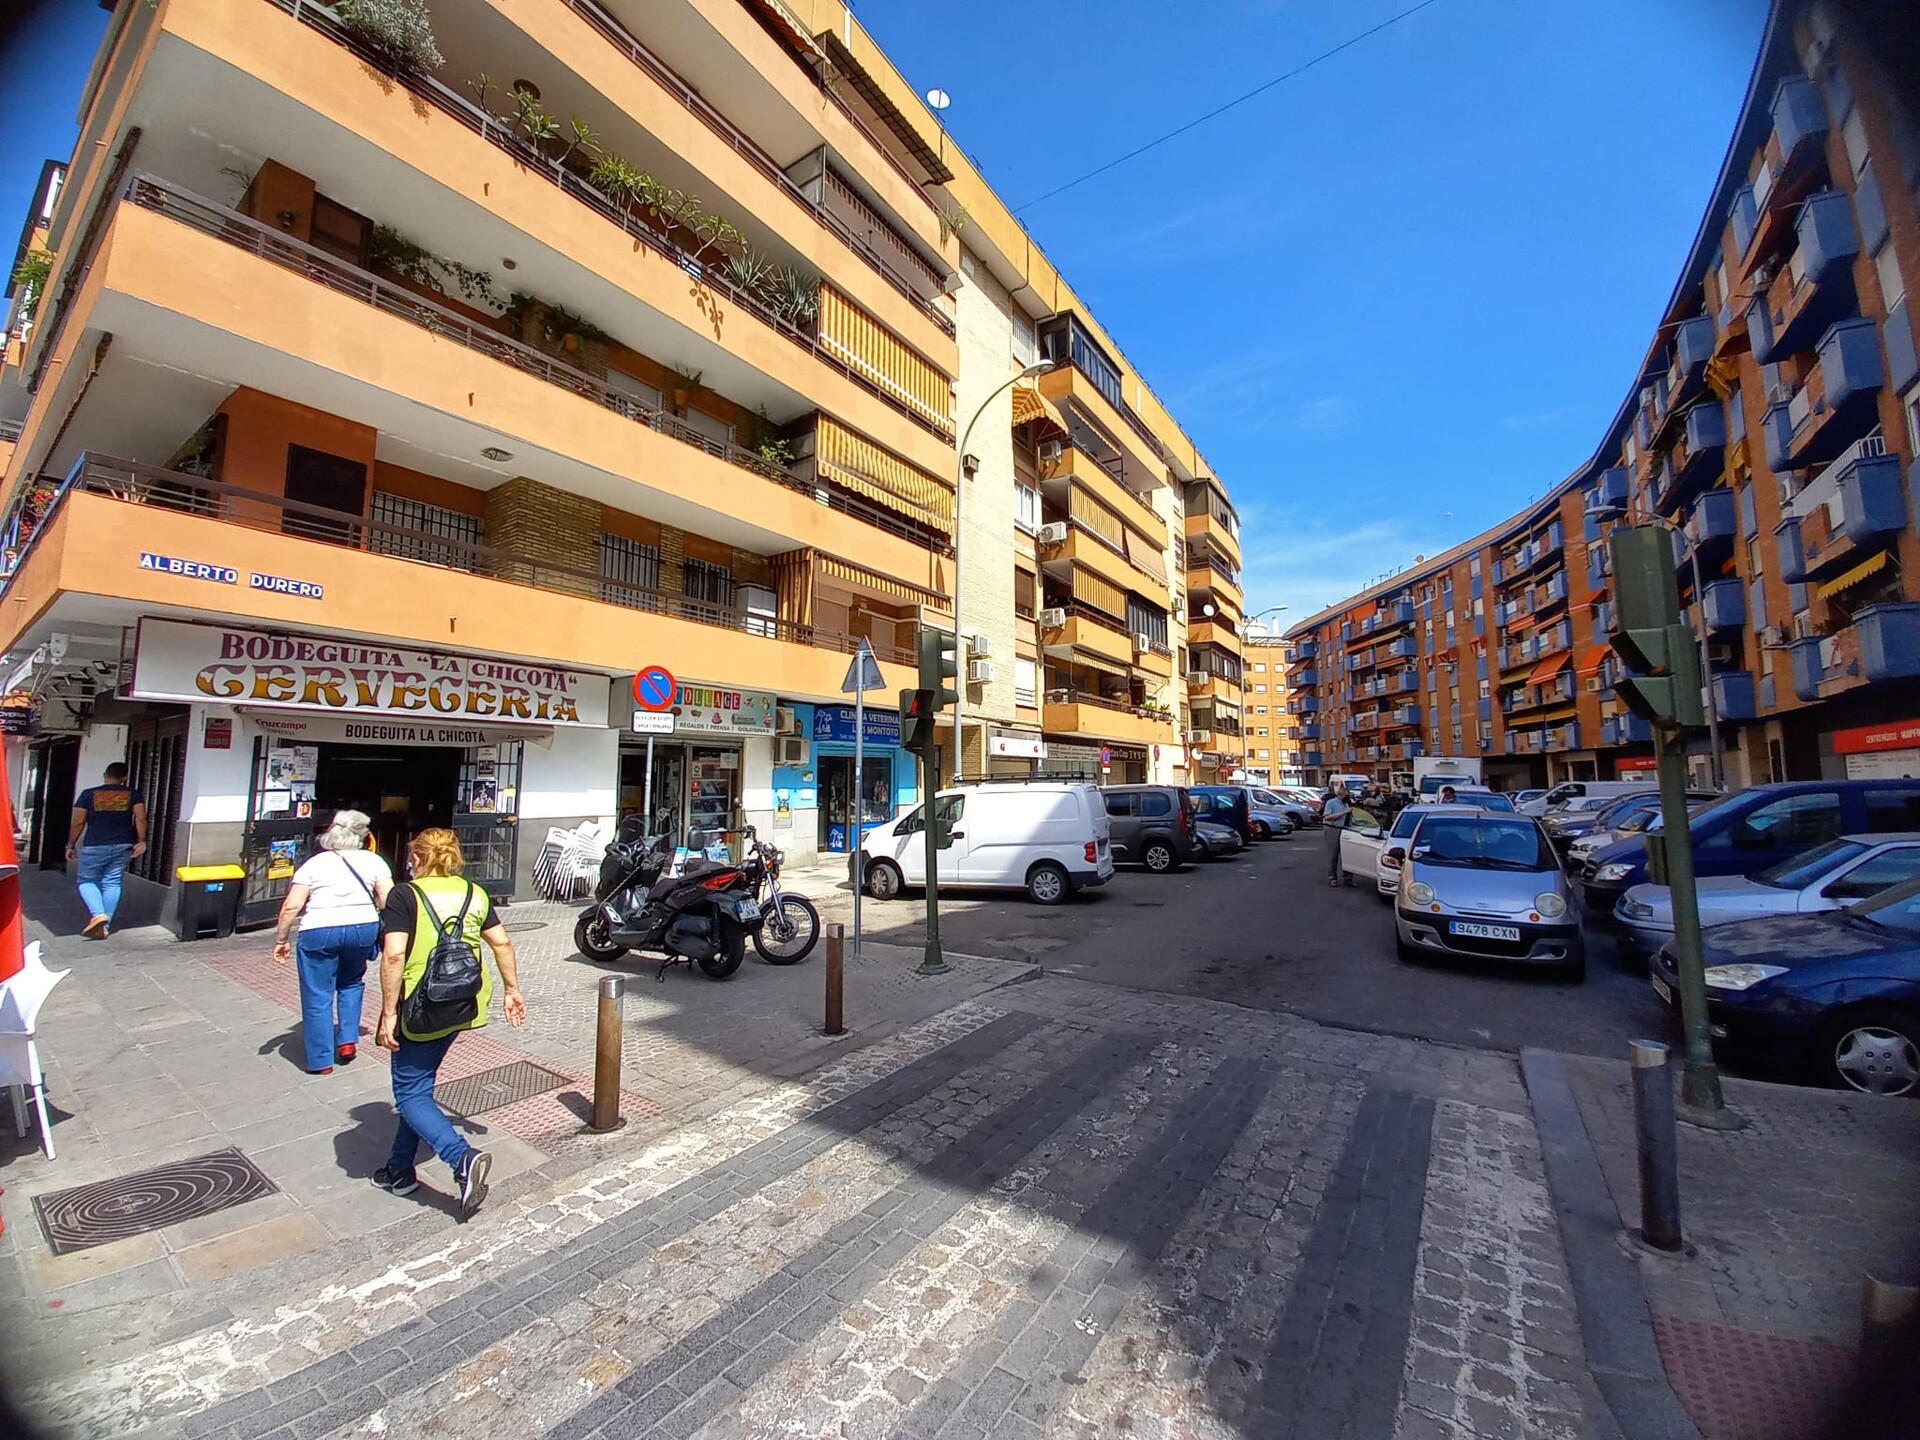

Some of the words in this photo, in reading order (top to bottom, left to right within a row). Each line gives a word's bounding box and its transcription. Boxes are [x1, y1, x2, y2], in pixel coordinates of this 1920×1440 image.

[141, 554, 237, 583] ALBERTO
[251, 574, 323, 598] DURERO
[219, 633, 404, 667] BODEGUITA
[195, 664, 580, 722] CERVECERIA
[255, 719, 307, 730] Cruzcampo
[680, 722, 704, 730] REGALOS
[867, 725, 899, 737] MONTOTO
[345, 724, 416, 741] BODEGUITA
[420, 729, 435, 742] LA
[1457, 924, 1488, 935] 9478
[1493, 927, 1517, 939] CXN
